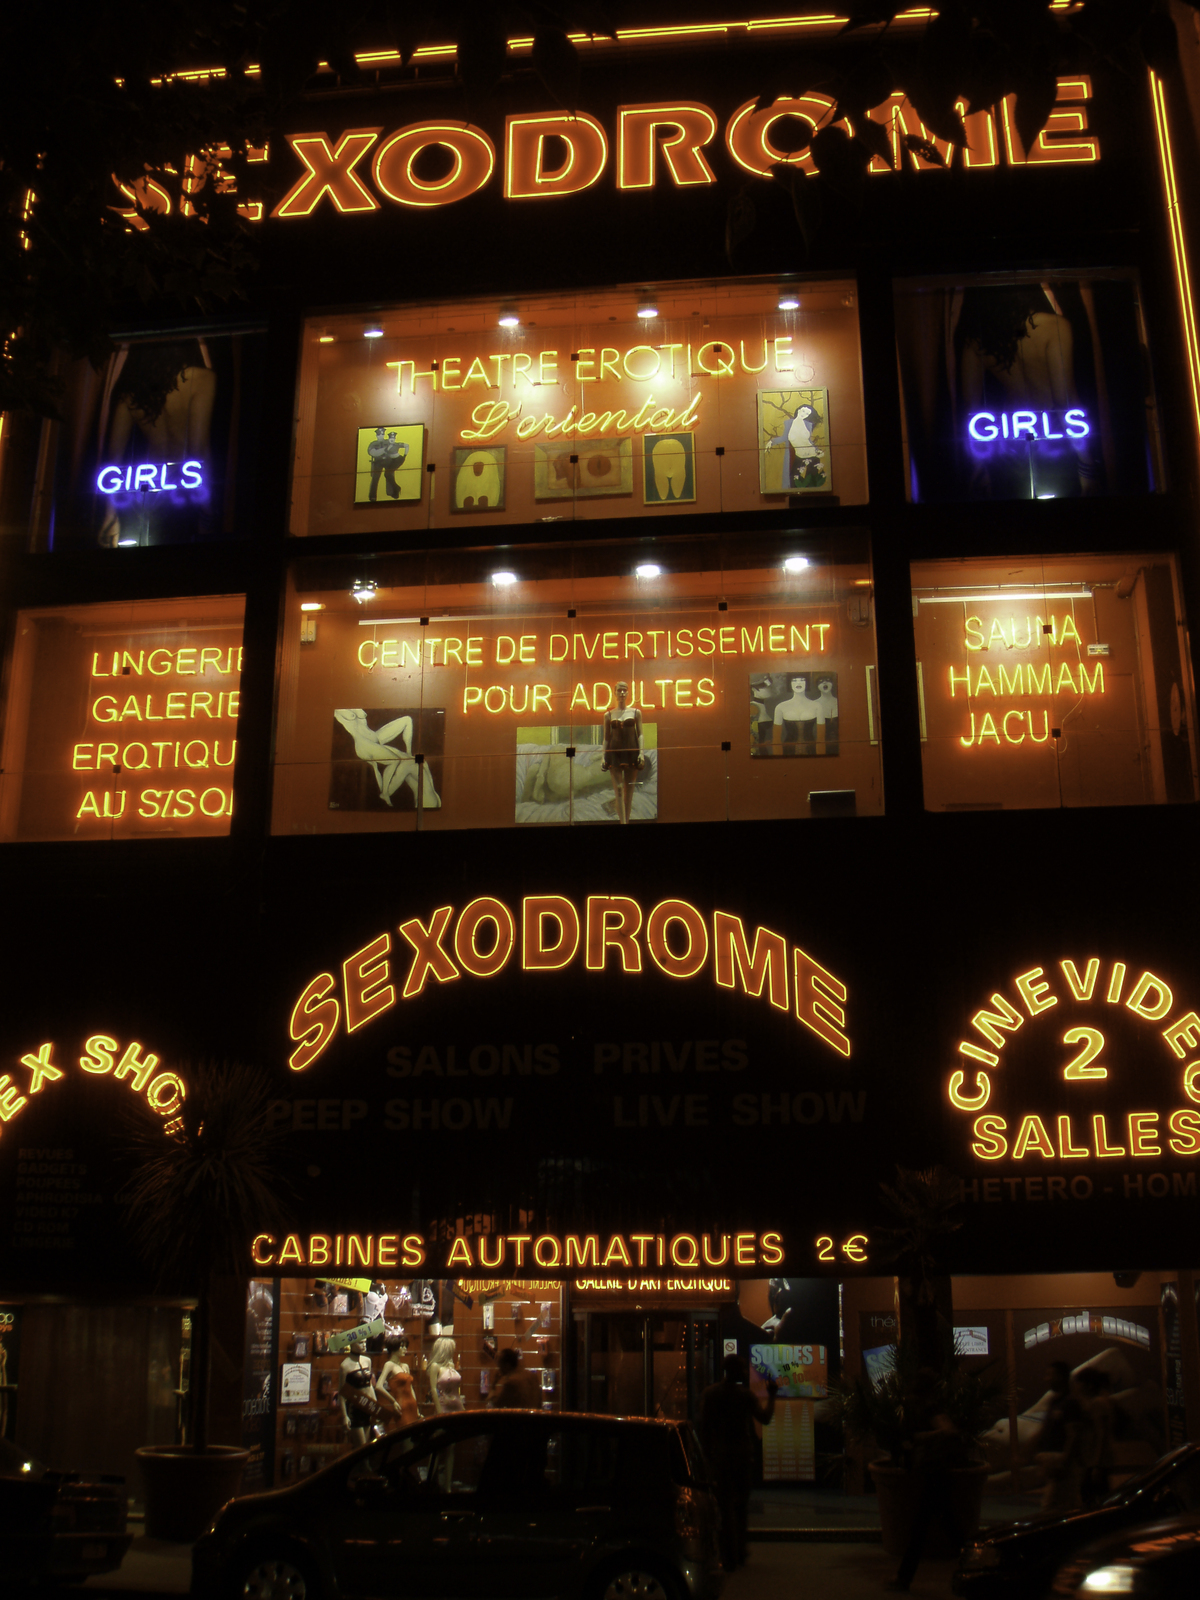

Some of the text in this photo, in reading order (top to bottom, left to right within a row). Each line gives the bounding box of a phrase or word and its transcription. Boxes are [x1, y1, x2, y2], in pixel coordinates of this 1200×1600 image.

[386, 336, 795, 395] THEATRE EROTIQUE
[967, 407, 1090, 441] GIRLS
[97, 459, 203, 494] GIRLS
[358, 624, 830, 668] CENTRE DE DIVERTISSEMENT
[965, 614, 1082, 650] SAUNA
[463, 677, 716, 713] POUR ADULTES
[950, 662, 1105, 697] HAMMAM
[92, 691, 240, 722] GALERIE
[960, 710, 1049, 746] JACU
[72, 740, 237, 770] EROTIQU
[76, 790, 127, 818] AU
[288, 894, 852, 1071] SEXODROME
[385, 1038, 749, 1078] SALONS PRIVES
[1063, 1026, 1107, 1080] 2
[266, 1096, 514, 1131] PEEP SHOW
[613, 1091, 867, 1128] LIVE SHOW
[972, 1109, 1200, 1160] SALLES
[960, 1175, 1094, 1201] HETERO
[250, 1233, 425, 1267] CABINES
[447, 1232, 785, 1268] AUTOMATIQUES
[346, 1332, 357, 1342] 30
[751, 1345, 813, 1365] SOLDES
